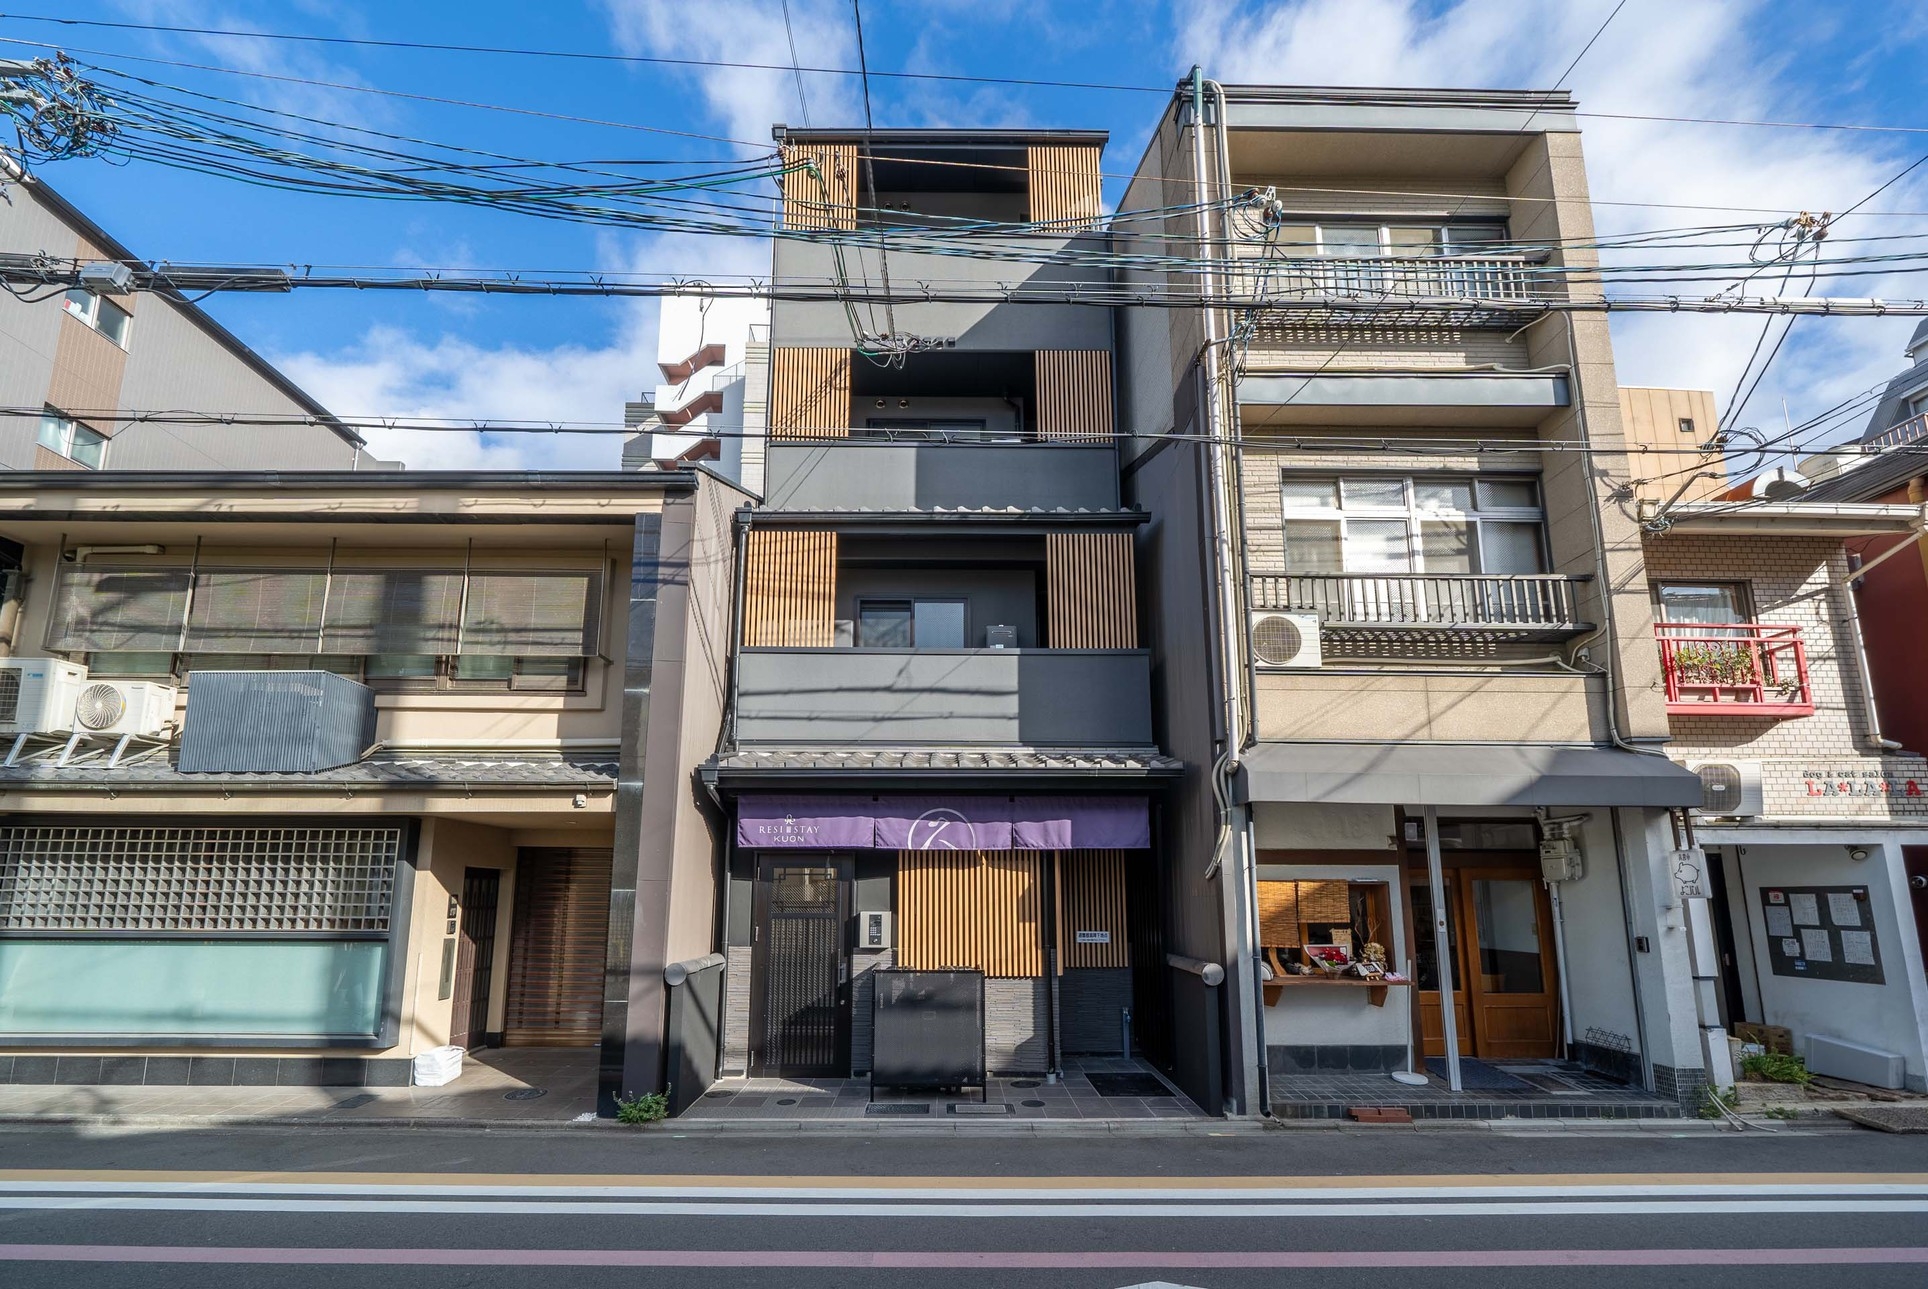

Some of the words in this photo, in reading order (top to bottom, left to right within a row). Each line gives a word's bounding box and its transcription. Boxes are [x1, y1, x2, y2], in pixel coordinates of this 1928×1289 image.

[1802, 770, 1823, 780] dog
[1837, 770, 1855, 778] cat
[1861, 770, 1894, 778] salon
[793, 826, 820, 834] STAY
[773, 835, 805, 843] KUON
